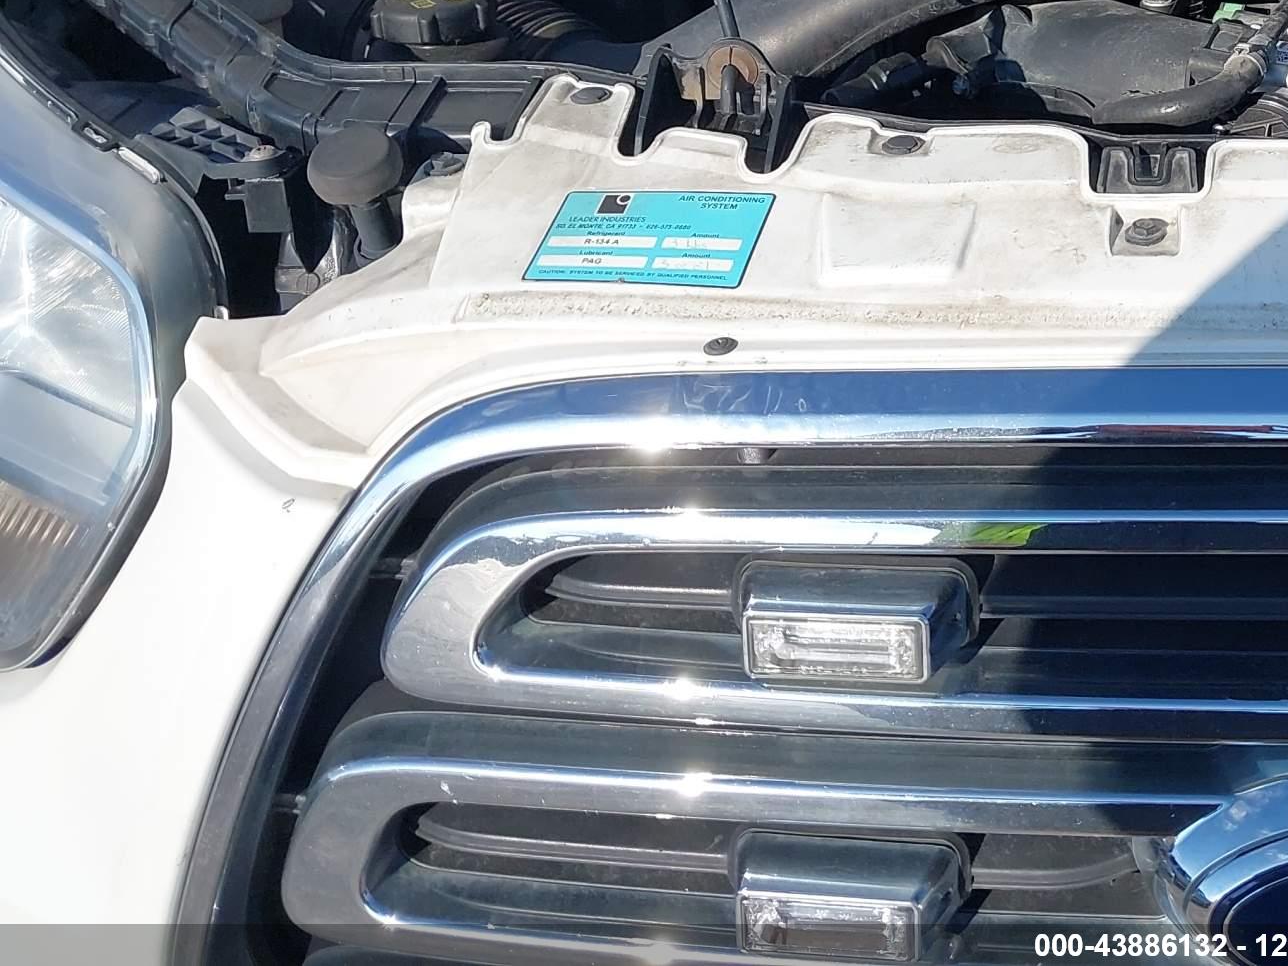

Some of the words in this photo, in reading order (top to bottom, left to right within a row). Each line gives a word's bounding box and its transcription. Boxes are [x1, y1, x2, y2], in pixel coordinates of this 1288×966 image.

[697, 195, 766, 204] CONDITIONING
[700, 202, 738, 210] SYSTEM
[581, 257, 602, 265] PAG
